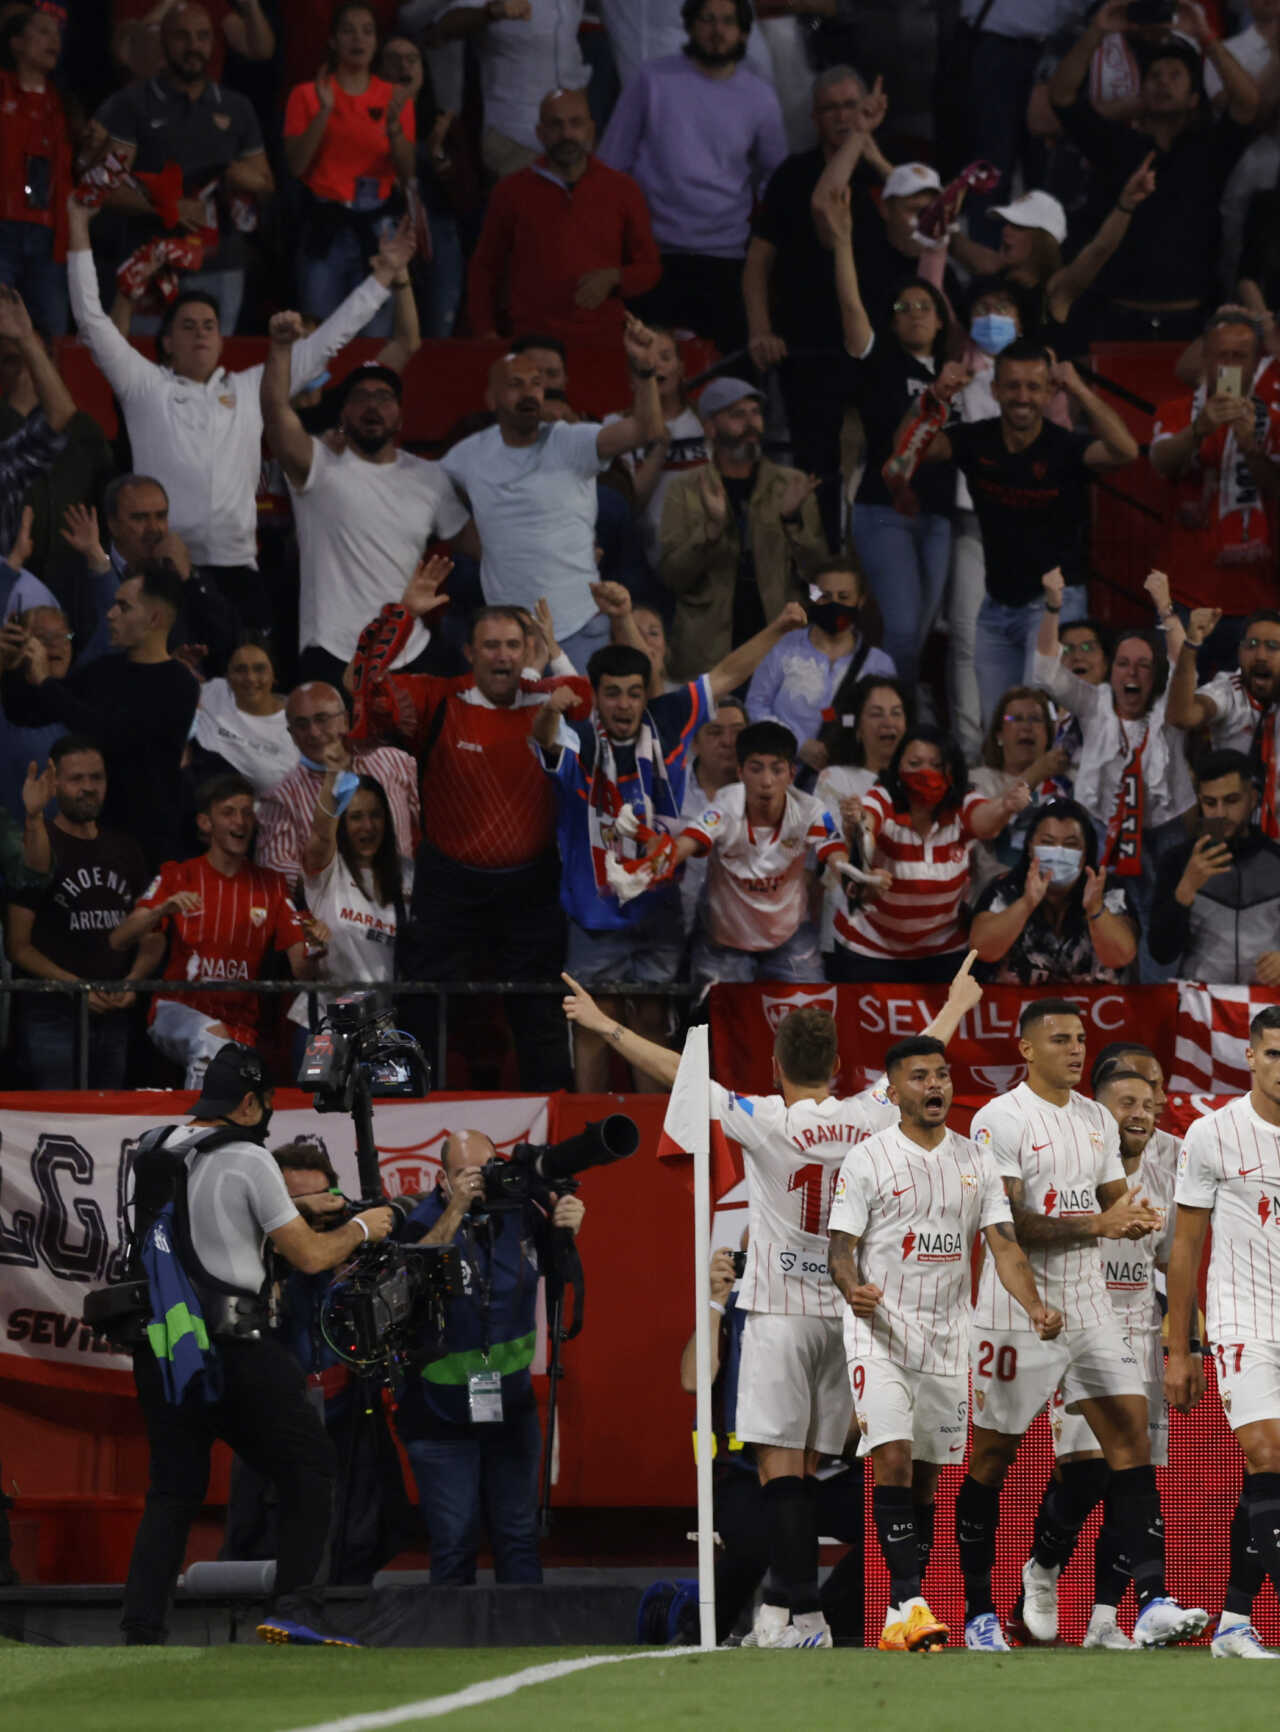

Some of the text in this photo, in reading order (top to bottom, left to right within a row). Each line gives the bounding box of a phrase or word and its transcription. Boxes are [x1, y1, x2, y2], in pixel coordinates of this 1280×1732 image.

[201, 957, 249, 980] NAGA
[1059, 1189, 1095, 1211] NAG
[918, 1232, 963, 1255] NAGA
[6, 1308, 134, 1355] SEVI
[978, 1340, 1017, 1382] 20
[853, 1365, 866, 1401] 9
